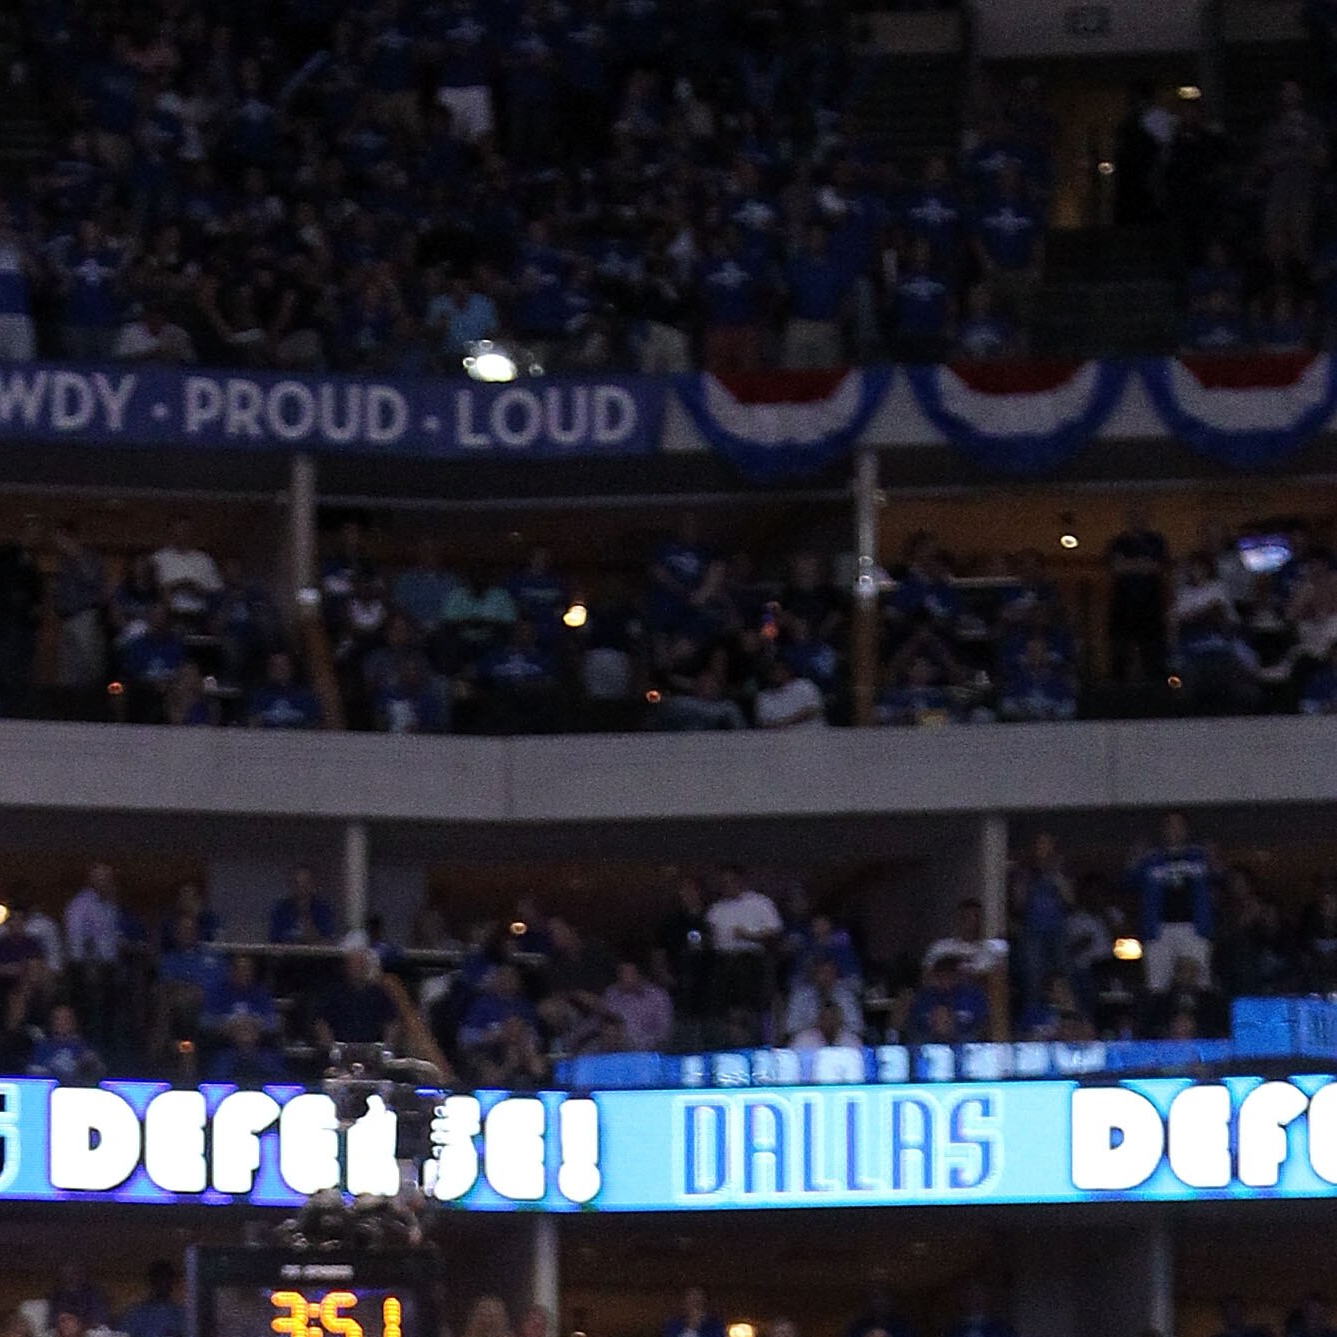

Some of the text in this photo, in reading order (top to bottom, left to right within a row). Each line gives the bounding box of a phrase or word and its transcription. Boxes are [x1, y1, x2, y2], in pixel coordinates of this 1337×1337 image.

[183, 377, 408, 443] PROUD
[456, 384, 638, 447] LOUD
[683, 1098, 993, 1195] DALLAS
